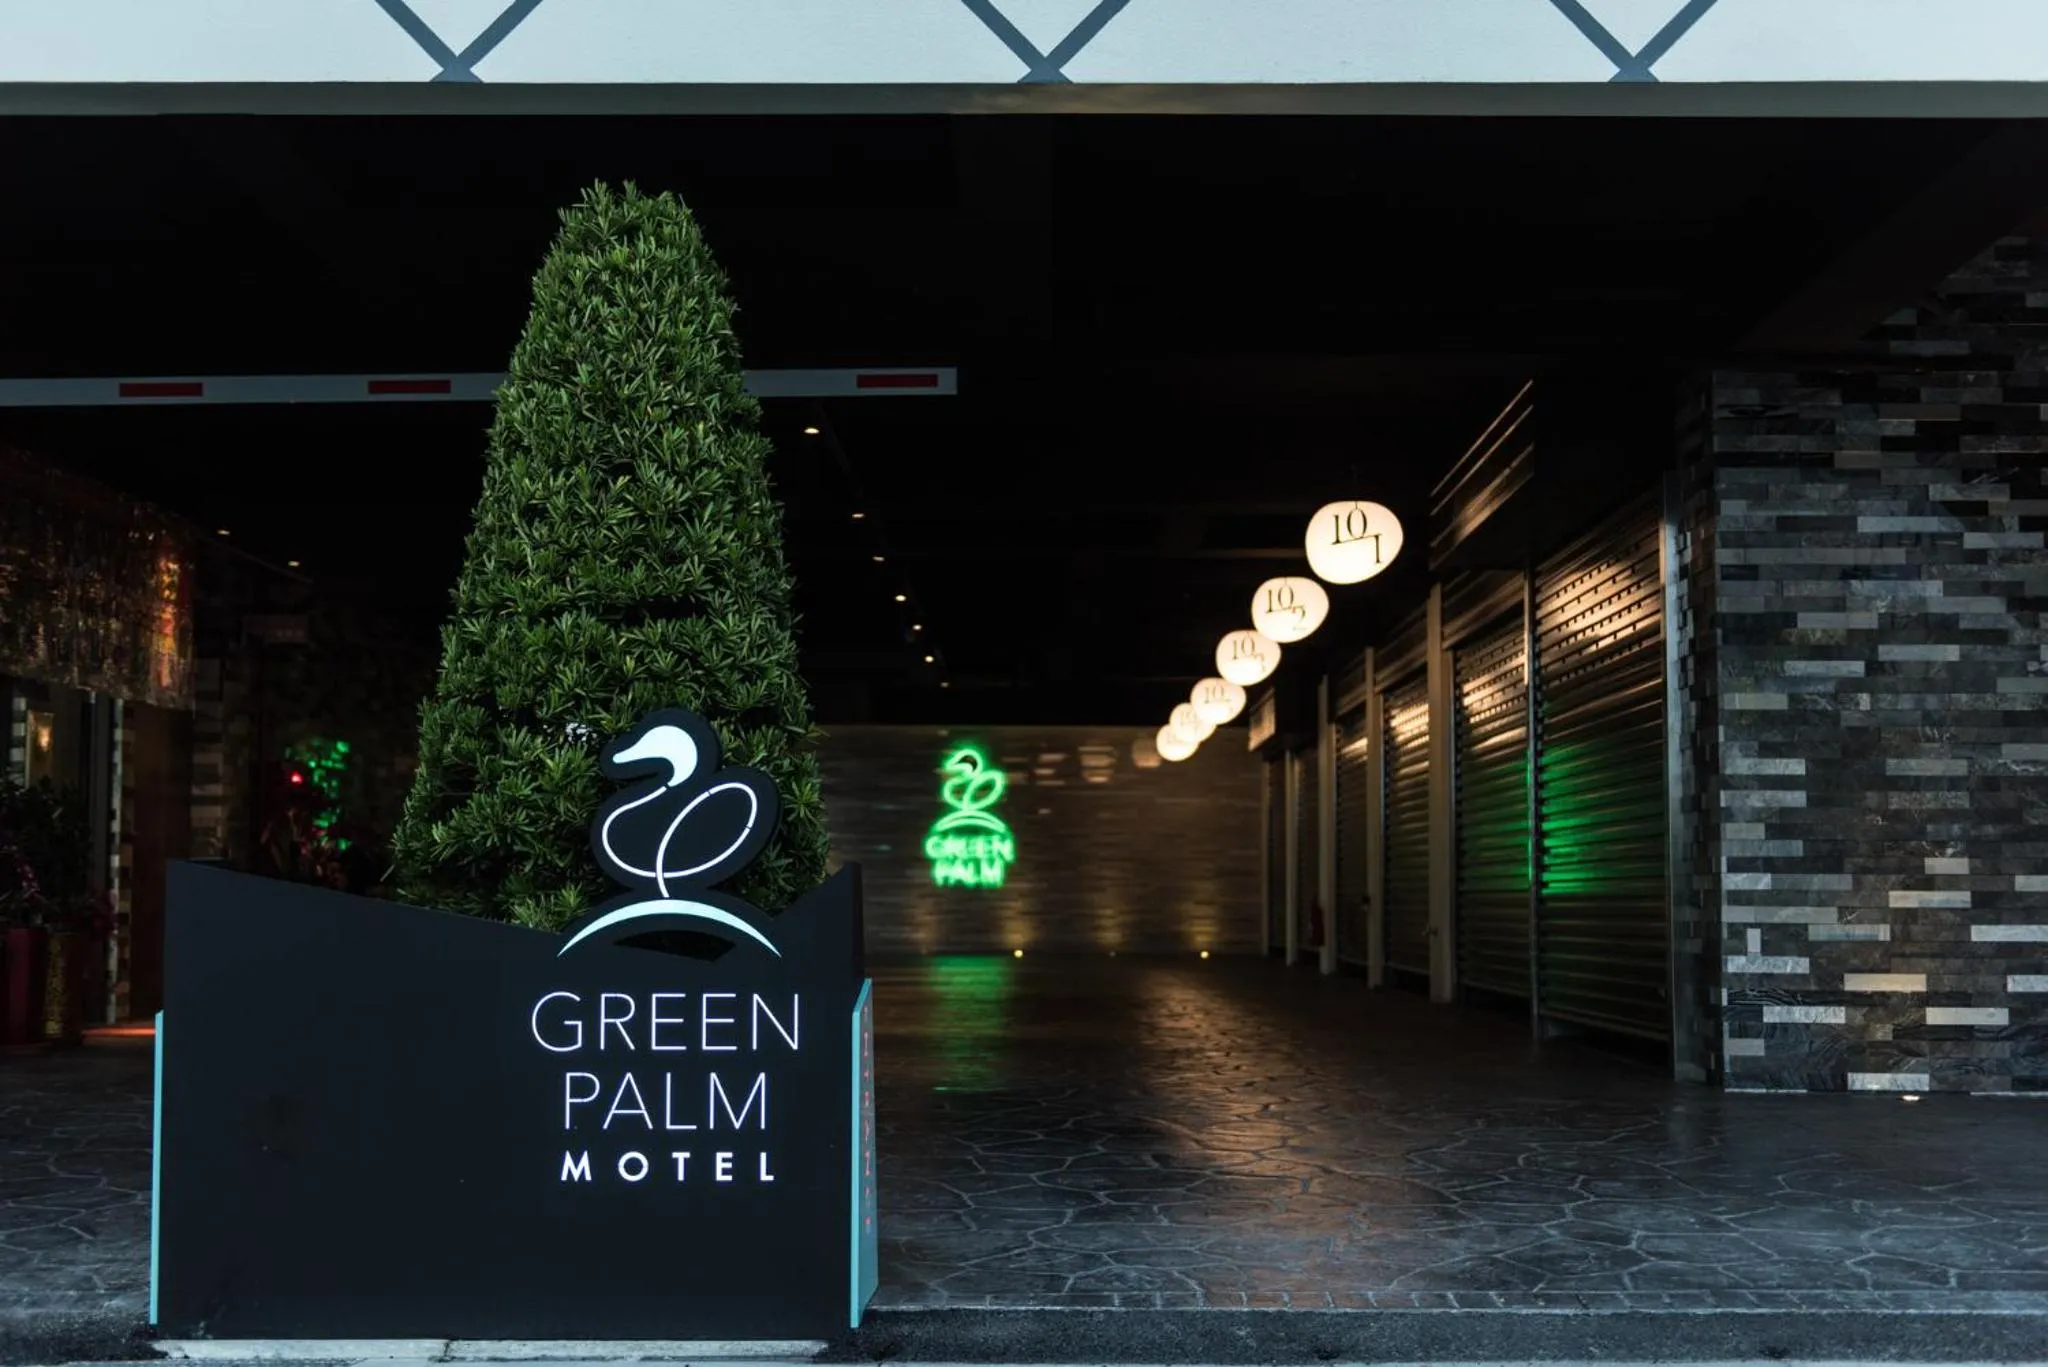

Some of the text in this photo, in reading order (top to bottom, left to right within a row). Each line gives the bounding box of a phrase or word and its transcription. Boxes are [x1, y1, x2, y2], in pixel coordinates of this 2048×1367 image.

[1331, 507, 1382, 564] 101
[1265, 584, 1306, 631] 102
[925, 834, 1014, 863] GREEN
[934, 858, 1004, 886] PALM
[531, 991, 799, 1052] GREEN
[564, 1072, 766, 1130] PALM
[560, 1151, 774, 1182] MOTEL
